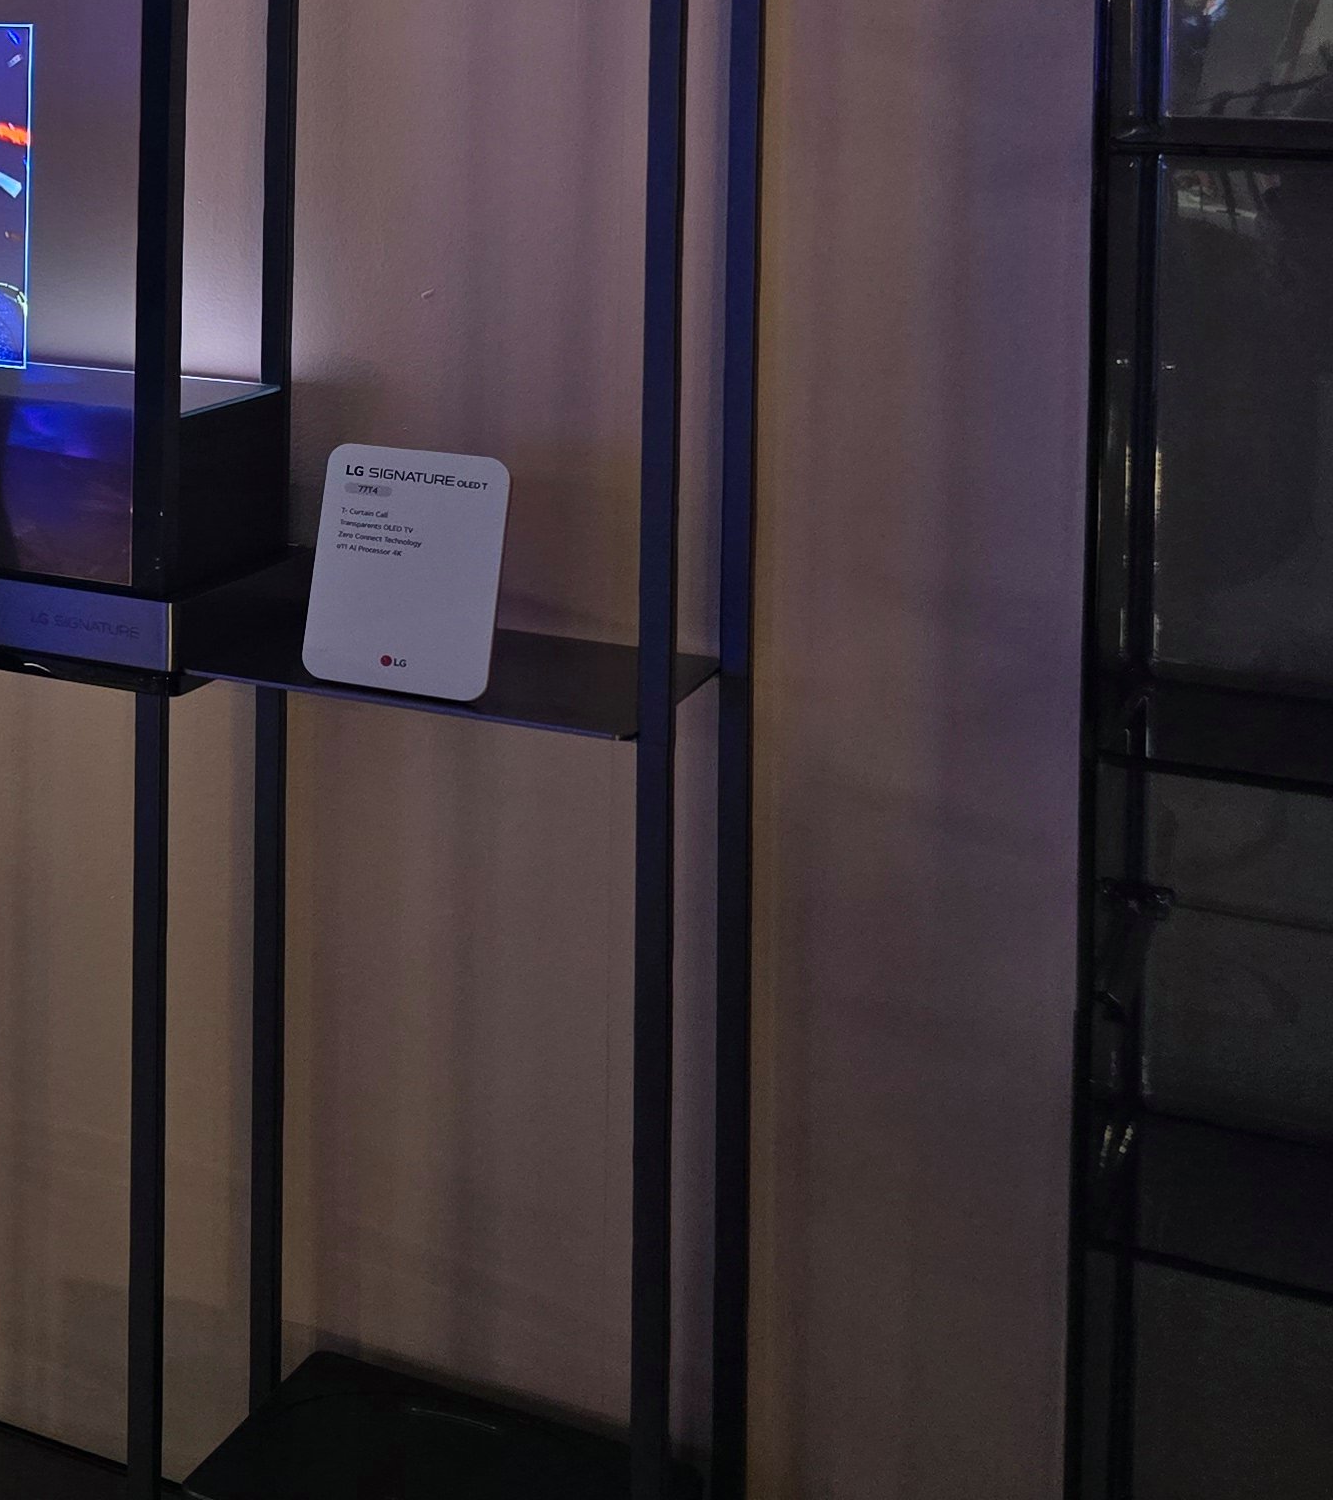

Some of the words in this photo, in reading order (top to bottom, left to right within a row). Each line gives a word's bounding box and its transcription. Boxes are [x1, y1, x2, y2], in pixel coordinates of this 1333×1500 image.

[346, 464, 364, 477] LG
[369, 467, 456, 487] SIGNATURE
[457, 480, 480, 490] OLED
[481, 482, 488, 491] T
[393, 658, 407, 668] LG
